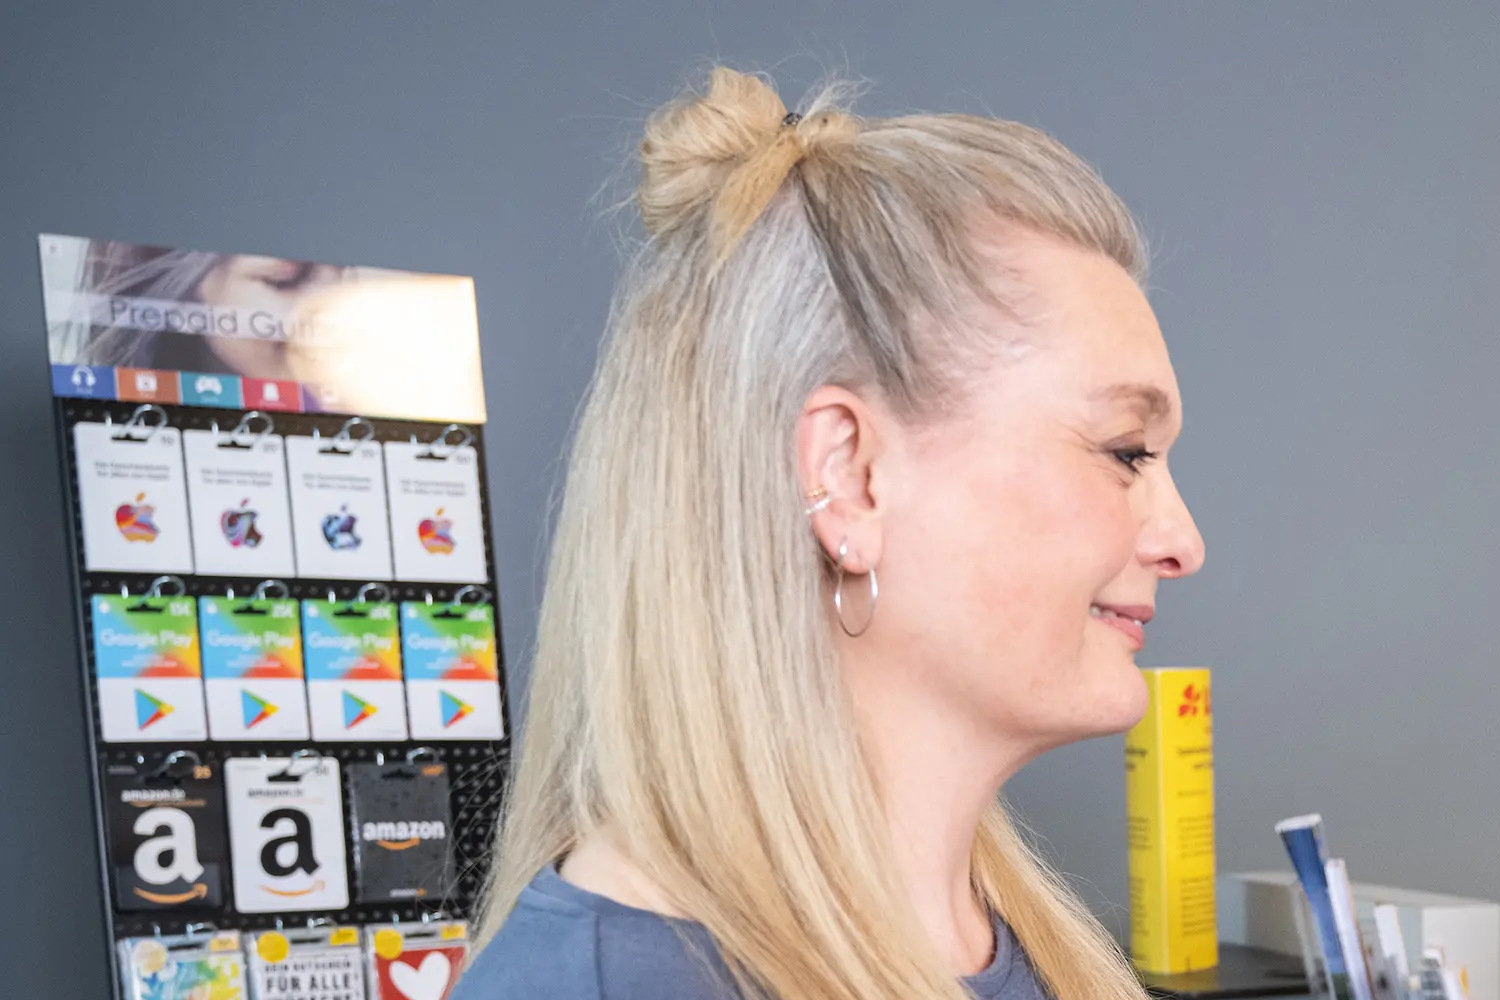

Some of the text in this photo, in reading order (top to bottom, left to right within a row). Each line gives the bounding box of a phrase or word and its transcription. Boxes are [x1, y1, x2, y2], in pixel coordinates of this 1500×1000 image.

[109, 298, 239, 335] Prepaid
[132, 807, 206, 885] a
[258, 807, 321, 878] a
[362, 820, 447, 842] amazon
[266, 972, 352, 993] FÜR ALLE
